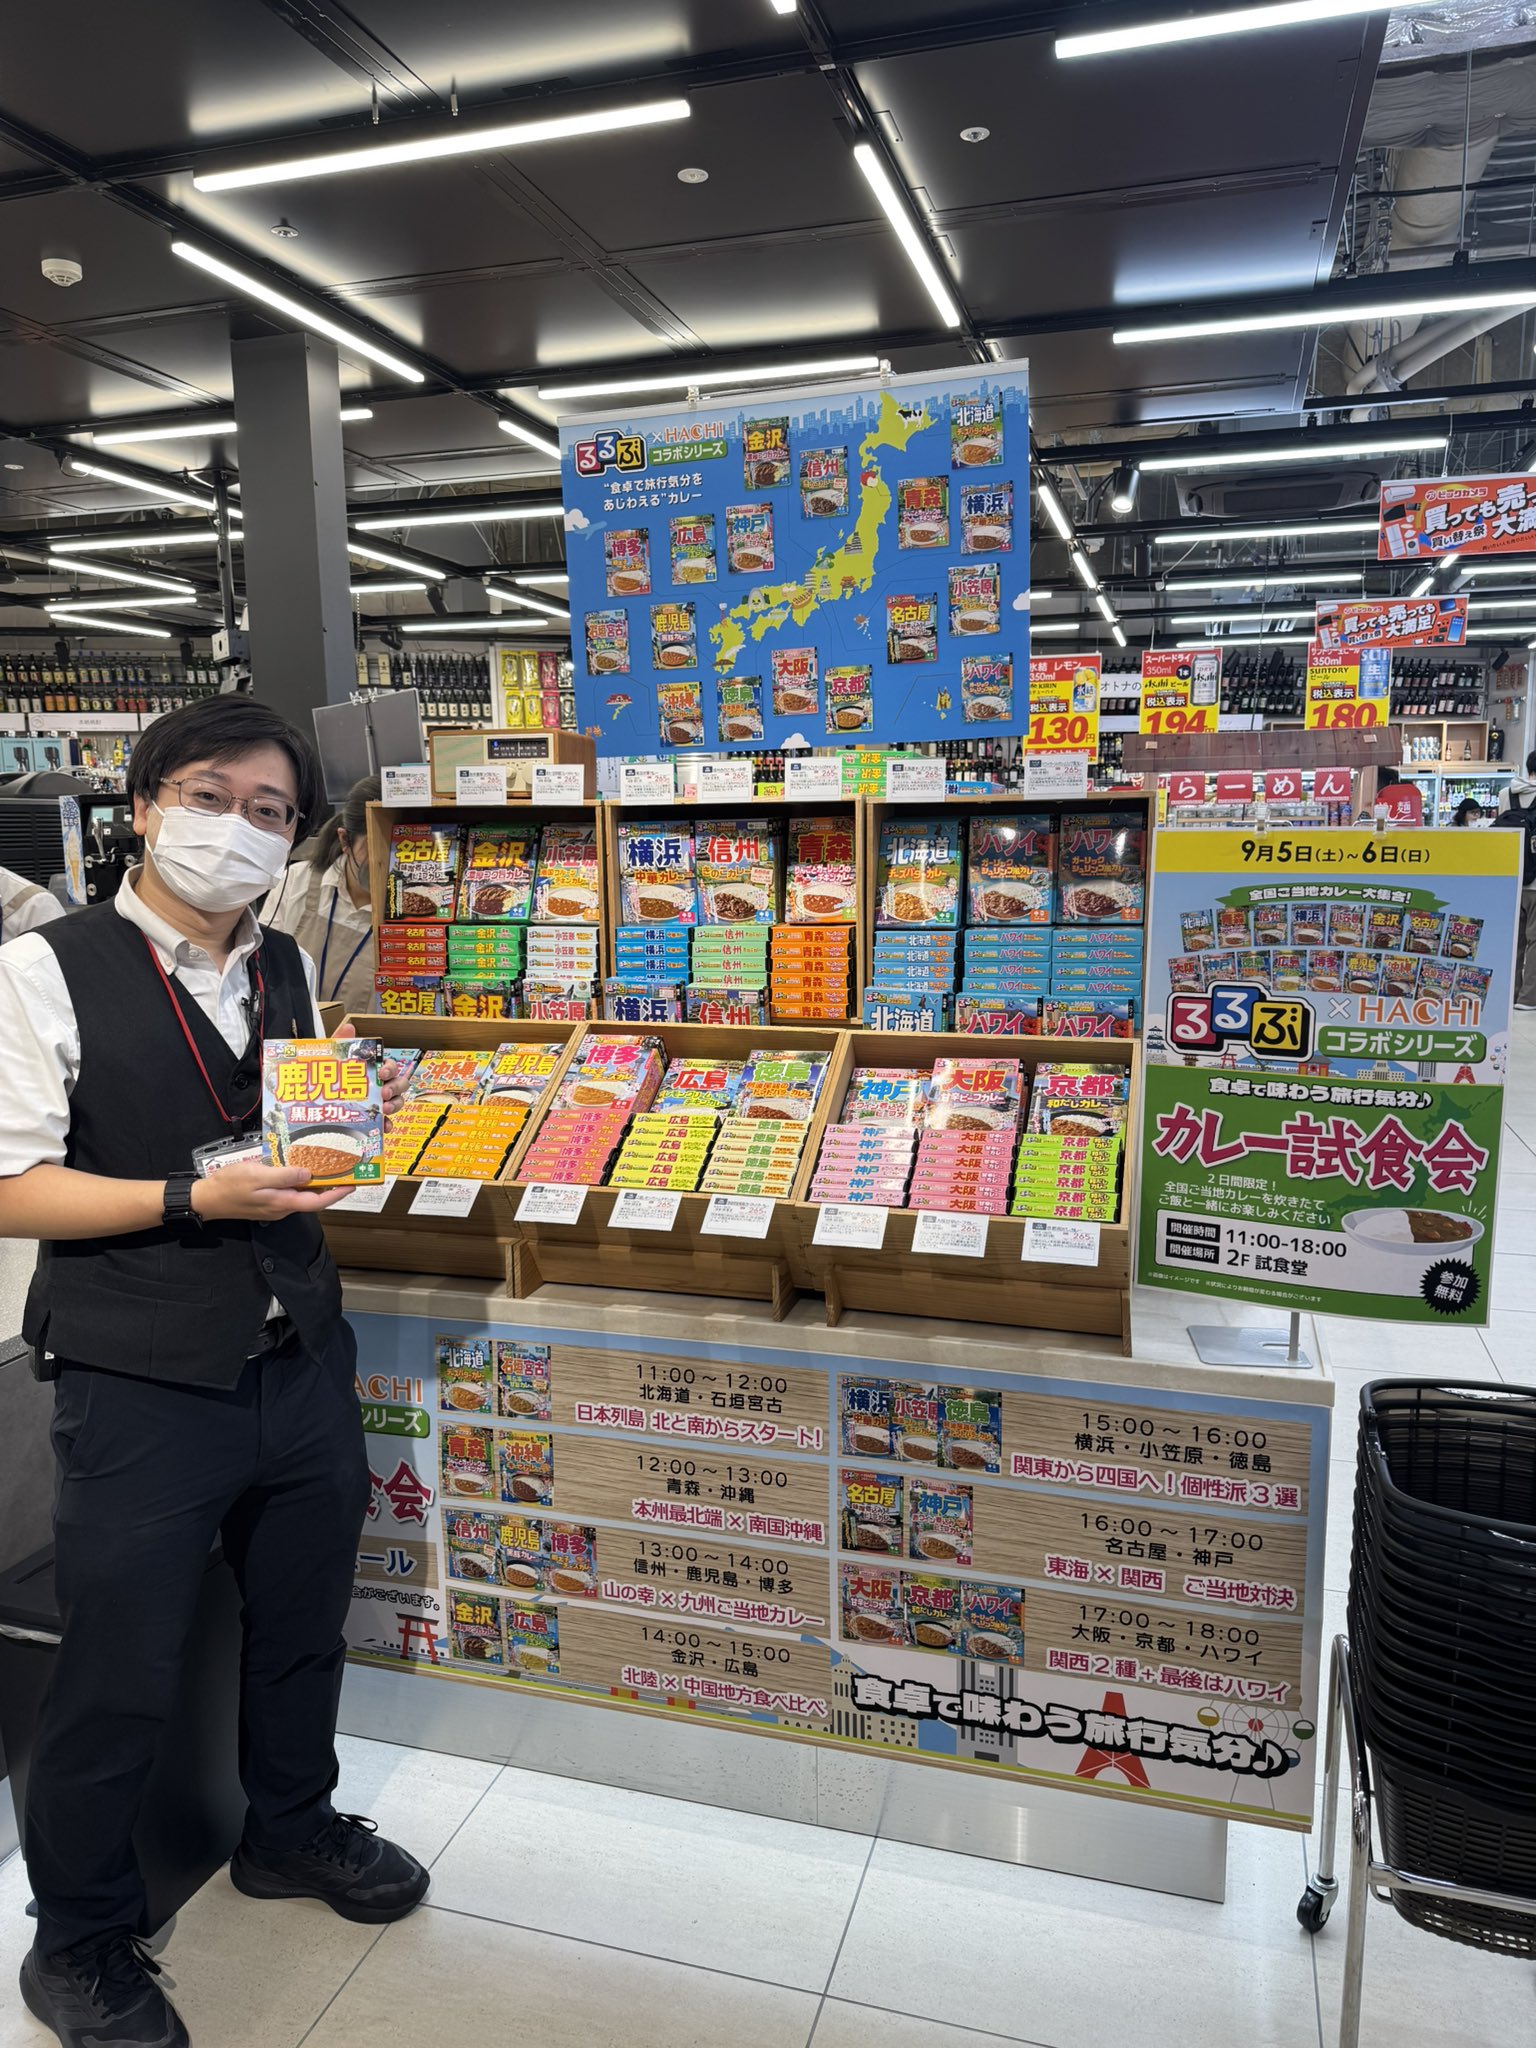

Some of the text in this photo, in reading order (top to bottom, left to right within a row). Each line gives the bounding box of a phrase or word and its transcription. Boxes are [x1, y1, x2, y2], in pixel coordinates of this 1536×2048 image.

[956, 404, 995, 427] 北海道
[665, 421, 724, 445] HACHI
[747, 427, 784, 453] 金沢
[653, 442, 724, 463] コラボシリーズ
[806, 457, 839, 478] 信州
[904, 487, 942, 509] 青森
[966, 492, 1005, 515] 横浜
[1438, 487, 1488, 500] ビックカメラ
[676, 525, 706, 545] 広島
[733, 513, 765, 534] 神戸
[611, 538, 642, 558] 博多
[1431, 523, 1487, 551] 買い替え祭
[953, 578, 994, 597] 小笠原
[655, 612, 690, 633] 鹿児島
[891, 604, 931, 624] 名古屋
[1343, 602, 1436, 636] 買っても売っても
[1348, 629, 1382, 645] 買い替え祭
[777, 657, 809, 676] 大阪
[1054, 660, 1082, 671] レモン
[1145, 653, 1191, 664] スーパードライ
[1146, 666, 1172, 675] 350ml
[1312, 657, 1342, 666] 350ml
[968, 662, 1002, 681] ハワイ
[1029, 671, 1056, 682] 350ml
[831, 673, 866, 695] 京都
[1100, 681, 1142, 692] オトナの
[1312, 688, 1355, 700] 税込表示
[663, 691, 696, 710] 沖縄
[1030, 701, 1068, 714] 税込表示
[1146, 696, 1186, 707] 税込表示
[1146, 709, 1208, 735] 194
[1309, 702, 1377, 731] 180
[1027, 715, 1089, 746] 130
[395, 839, 452, 864] 名古屋
[471, 841, 527, 868] 金沢
[544, 844, 598, 868] 小笠原
[628, 837, 683, 868] 横浜
[707, 834, 760, 865] 信州
[798, 833, 853, 863] 青森
[887, 836, 951, 865] 北海道
[724, 929, 745, 941] 信州
[1372, 913, 1478, 936] 金沢 京都
[381, 989, 437, 1015] 名古屋
[452, 994, 503, 1019] 金沢
[530, 1000, 586, 1022] 小笠原
[613, 997, 669, 1023] 横浜
[699, 1001, 751, 1026] 信州
[870, 1005, 935, 1033] 北海道
[966, 1012, 1026, 1036] ハワイ
[1052, 1014, 1116, 1038] ハワイ
[1176, 990, 1482, 1047] るるぶ HACHI
[585, 1044, 641, 1066] 博多
[1326, 1030, 1479, 1059] コラボシリーズ
[420, 1060, 479, 1082] 沖縄
[495, 1053, 558, 1076] 鹿児島
[753, 1060, 812, 1083] 徳島
[275, 1058, 370, 1103] 鹿児島
[672, 1068, 729, 1091] 広島
[859, 1079, 920, 1101] 神戸
[942, 1069, 1007, 1092] 大阪
[1043, 1074, 1118, 1098] 京都
[288, 1104, 361, 1124] 黒豚カレー
[1046, 1099, 1109, 1110] 和だしカレー
[961, 1131, 987, 1143] 大阪
[1062, 1137, 1090, 1148] 京都
[1153, 1103, 1488, 1194] カレー試食会
[1164, 1180, 1325, 1211] 全国ご当地カレーを炊きたて
[1158, 1193, 1331, 1226] ご飯と一緒にお楽しみください
[1170, 1222, 1347, 1258] 開催時間 11:00-18:00
[1169, 1243, 1308, 1277] 開催場所 2F 試食堂
[1440, 1270, 1469, 1290] 参加
[1434, 1284, 1464, 1304] 無料
[446, 1347, 485, 1369] 北海道
[639, 1383, 783, 1414] 北海道・石垣宮古
[848, 1388, 891, 1413] 横浜
[448, 1435, 487, 1459] 青森
[505, 1441, 544, 1463] 沖縄
[1074, 1432, 1272, 1473] 横浜・小笠原・徳島
[666, 1478, 755, 1504] 青森・沖縄
[846, 1482, 896, 1509] 名古屋
[919, 1490, 963, 1517] 神戸
[454, 1519, 490, 1540] 信州
[500, 1525, 540, 1551] 鹿児島
[551, 1532, 588, 1556] 博多
[1105, 1536, 1235, 1568] 名古屋・神戸
[633, 1557, 794, 1595] 信州・鹿児島・博多
[850, 1576, 893, 1600] 大阪
[908, 1584, 954, 1610] 京都
[1185, 1575, 1296, 1609] ご当地対決
[454, 1602, 494, 1626] 金沢
[967, 1594, 1012, 1616] ハワイ
[513, 1609, 549, 1633] 広島
[1072, 1624, 1264, 1667] 大阪・京都・ハワイ
[670, 1648, 759, 1679] 金沢・広島
